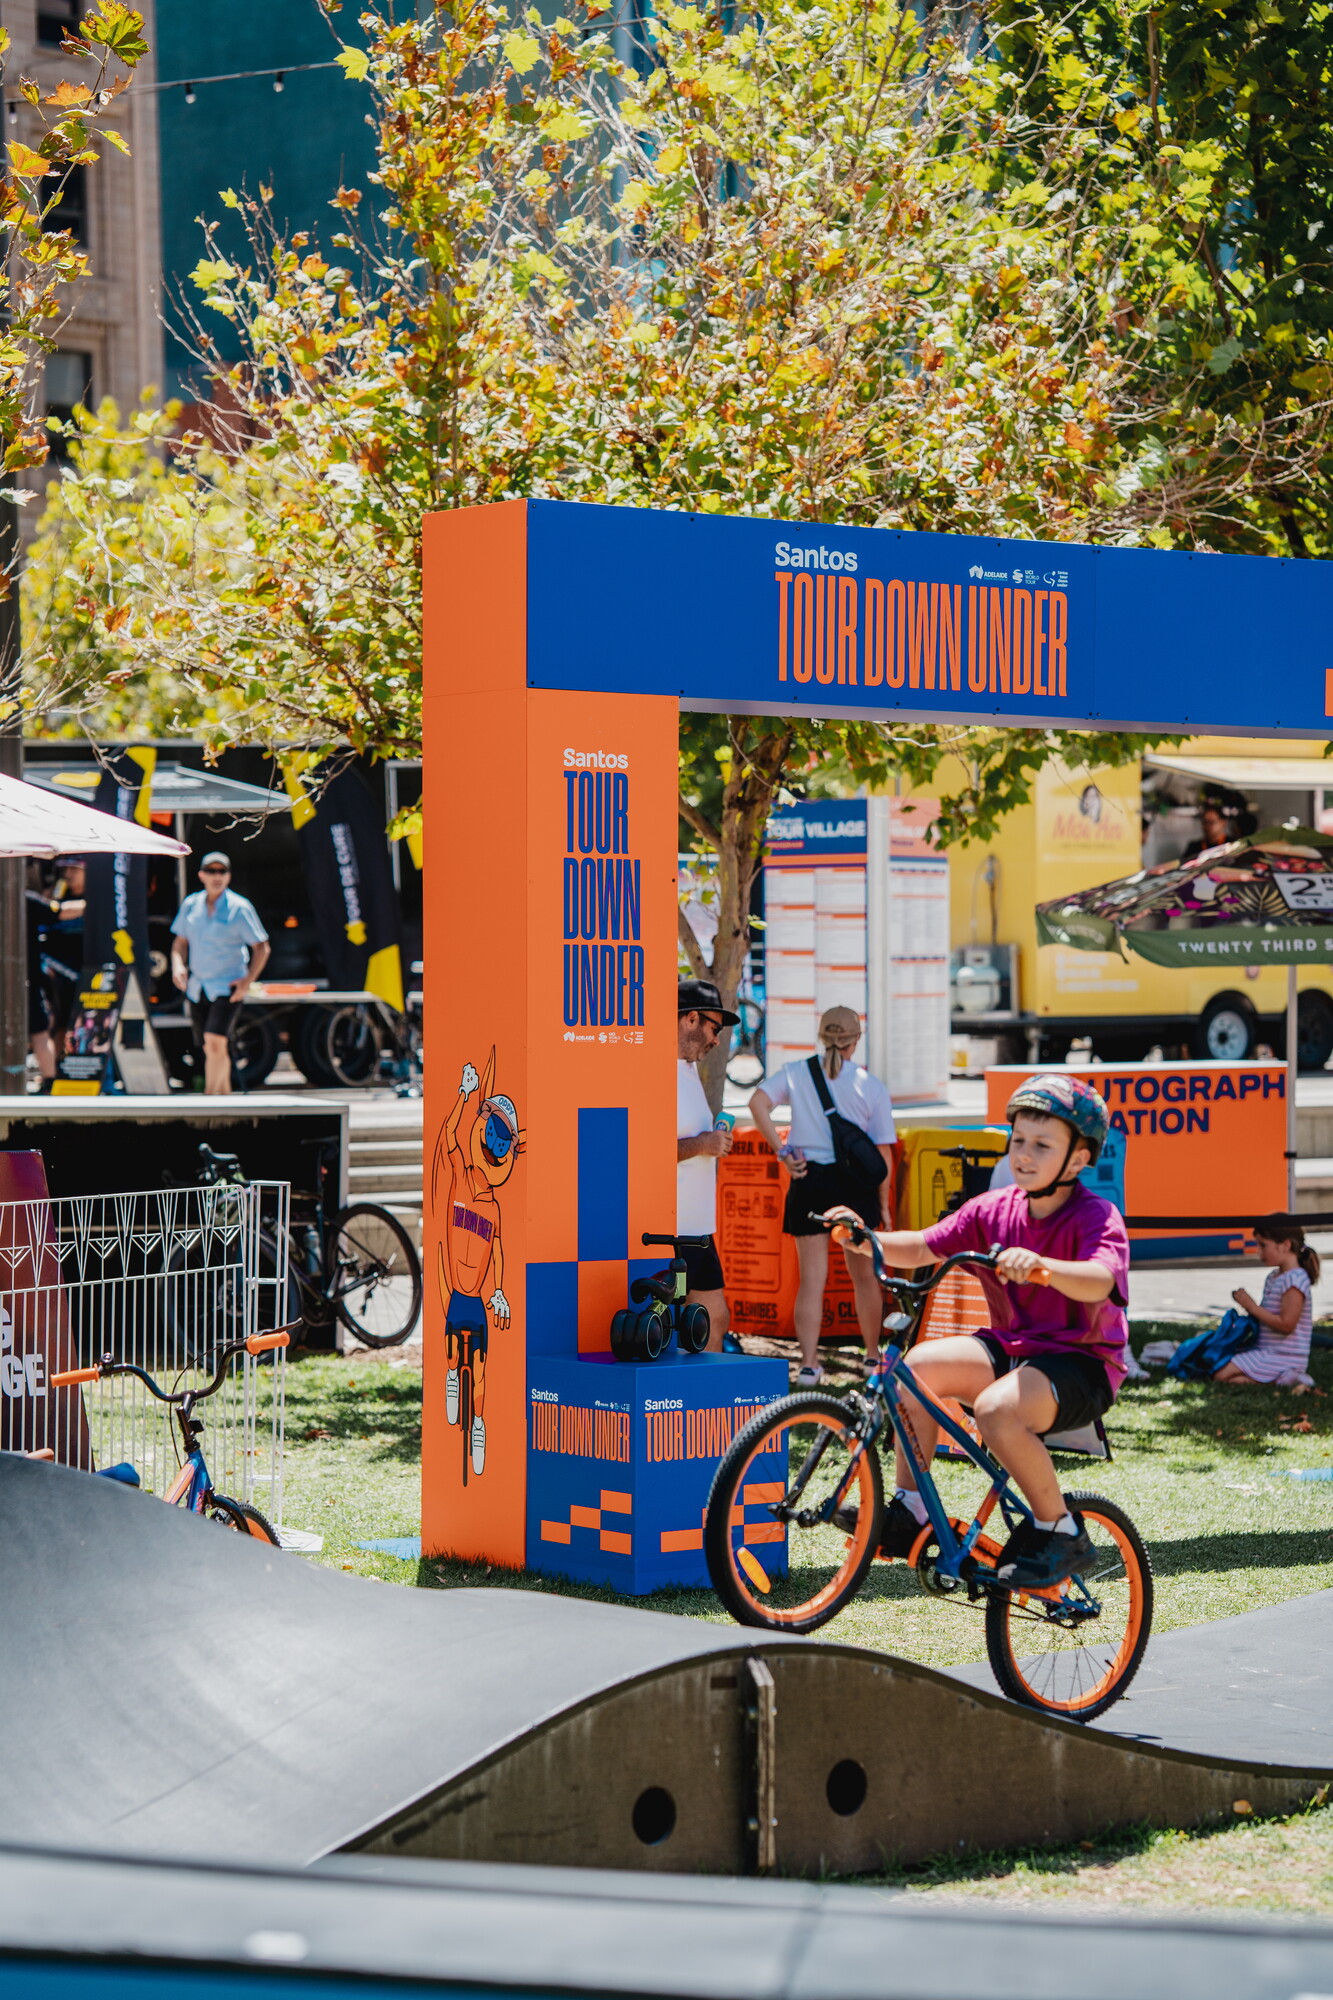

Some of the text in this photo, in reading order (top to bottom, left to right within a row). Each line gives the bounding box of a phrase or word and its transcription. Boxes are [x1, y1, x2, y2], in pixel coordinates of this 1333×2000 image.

[774, 541, 858, 572] Santos
[983, 571, 1008, 579] ADELAIDE
[774, 571, 1068, 697] TOUR DOWN UNDER
[563, 747, 629, 769] Santos
[563, 770, 629, 854] TOUR
[805, 819, 866, 838] VILLAGE
[563, 857, 641, 941] DOWN
[1177, 940, 1253, 954] TWENTY
[1261, 938, 1317, 952] THIRD
[563, 944, 645, 1027] UNDER
[1088, 1073, 1286, 1103] UTOGRAPH
[1109, 1107, 1210, 1135] ATION
[531, 1388, 559, 1402] Santos
[644, 1398, 683, 1411] Santos
[531, 1401, 630, 1463] TOUR DOWN UNDER
[644, 1410, 684, 1462] TOUR
[686, 1407, 732, 1459] DOWN
